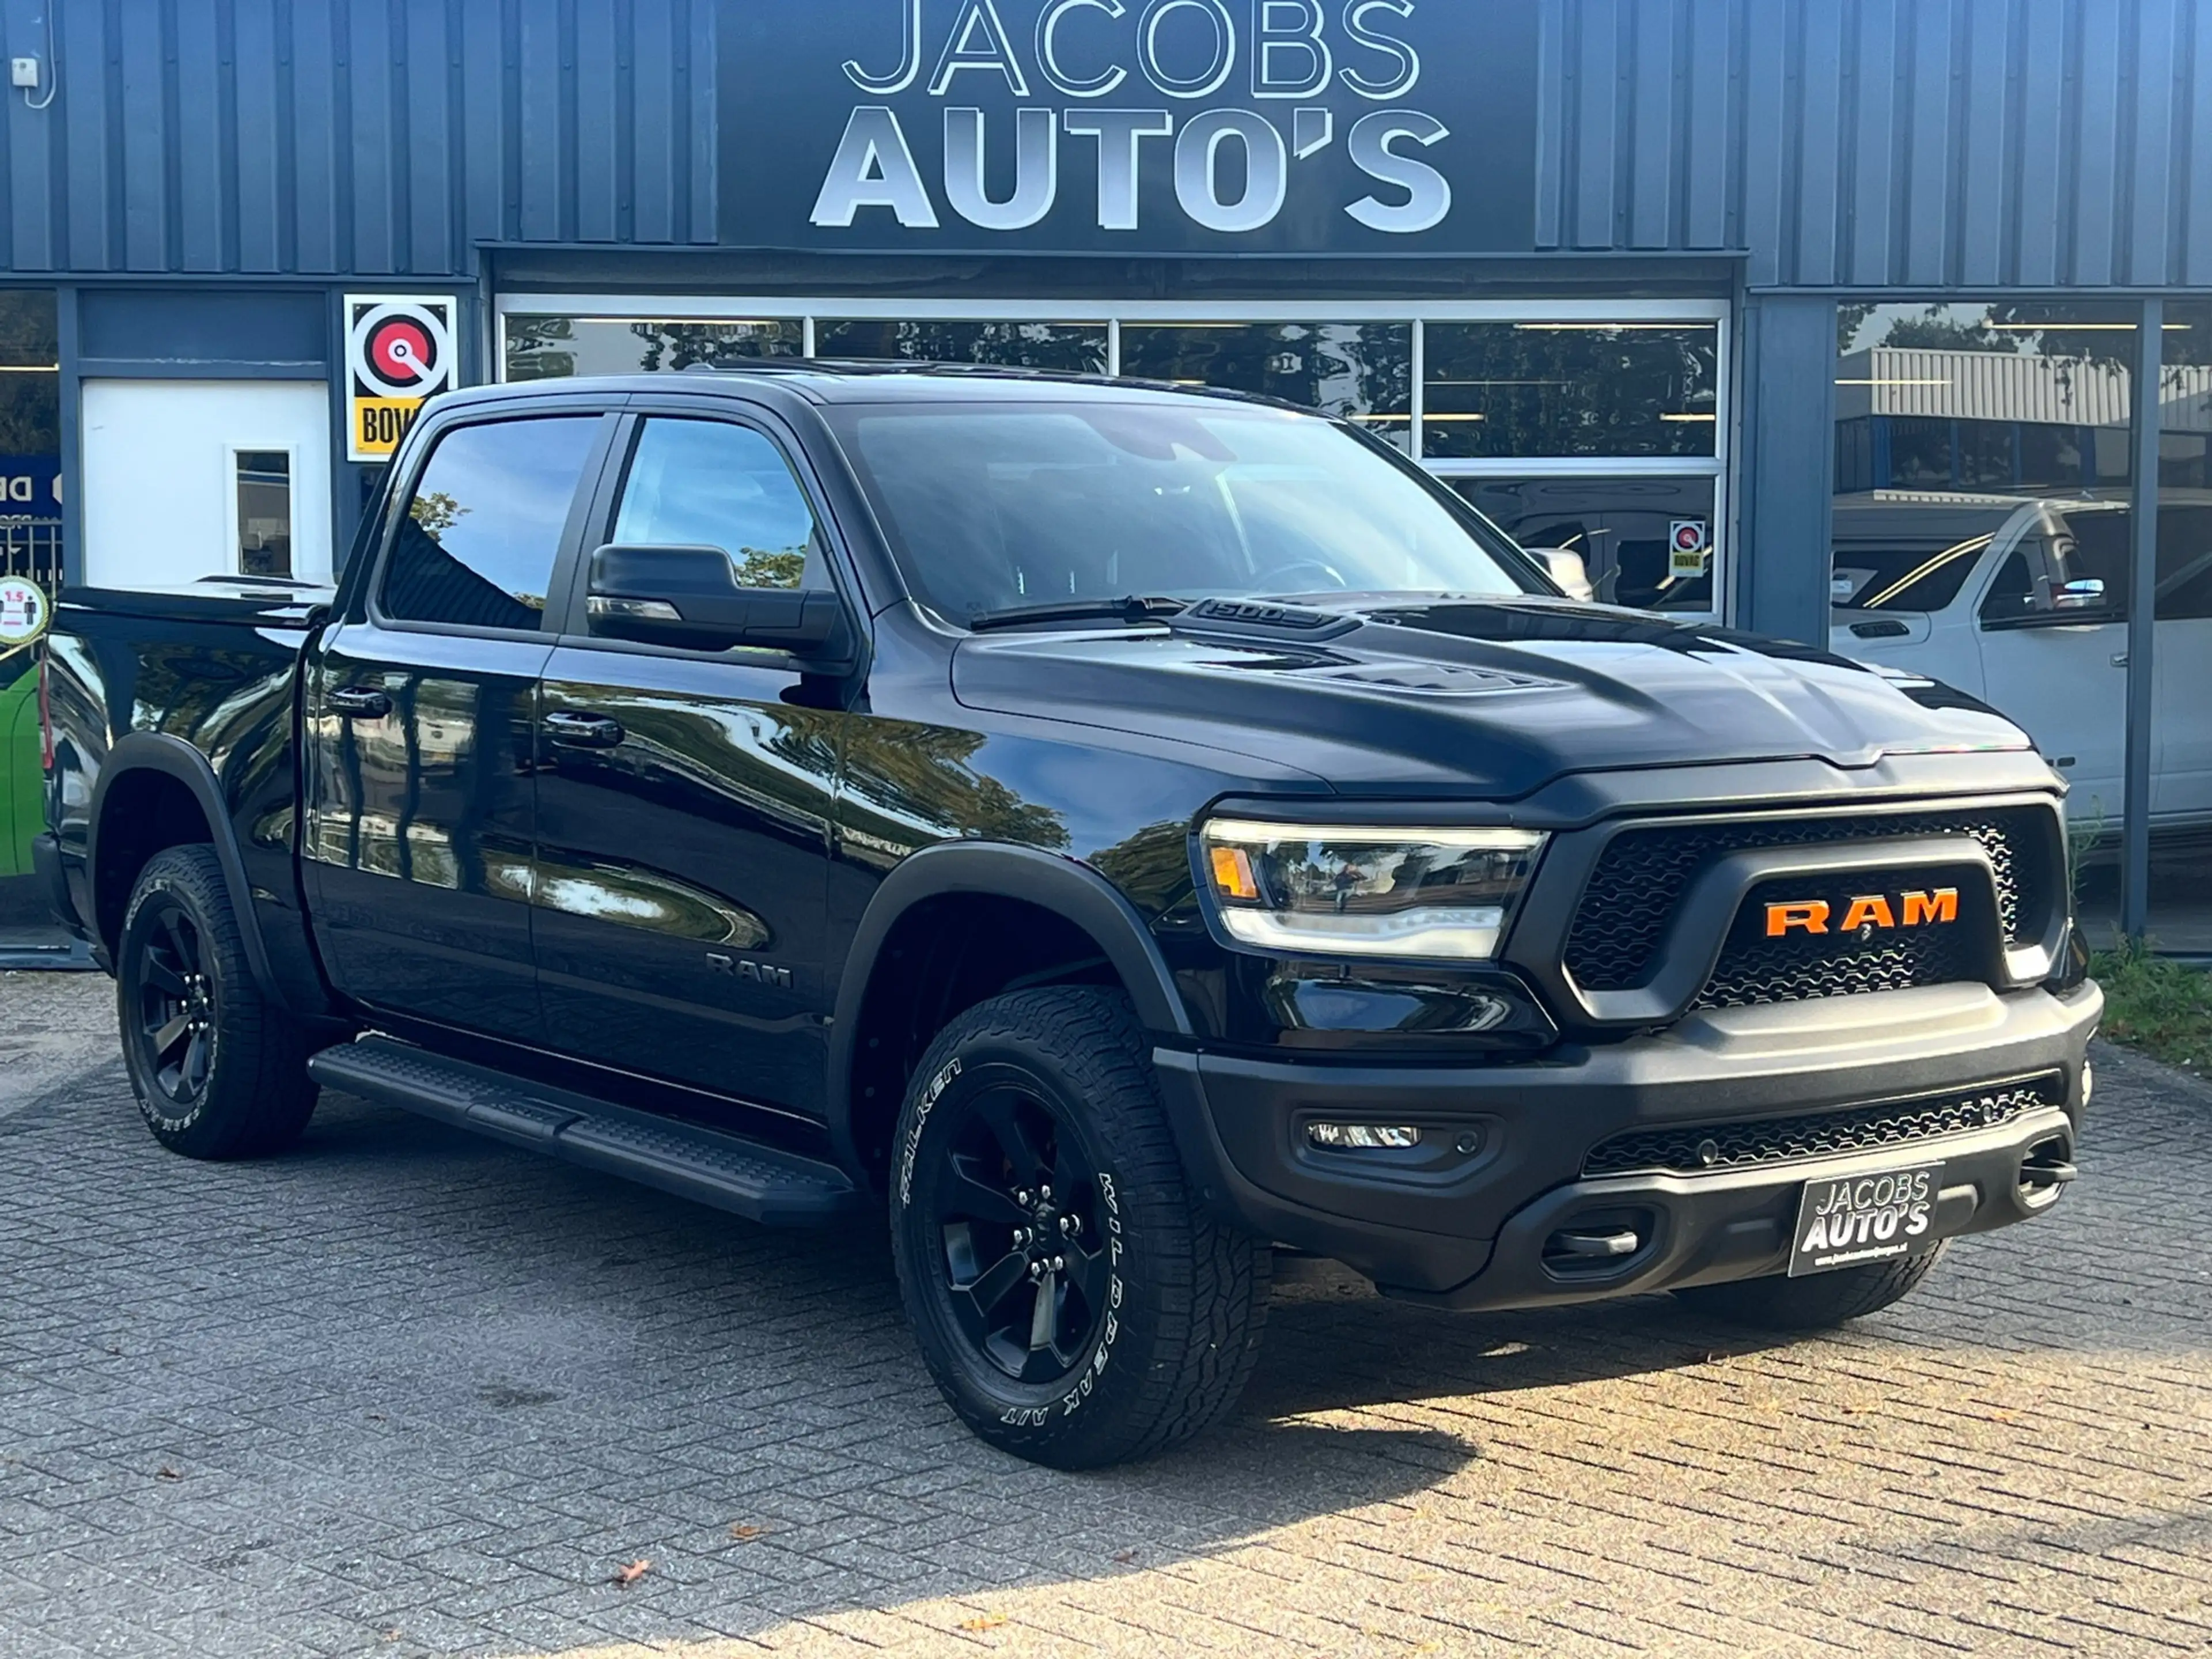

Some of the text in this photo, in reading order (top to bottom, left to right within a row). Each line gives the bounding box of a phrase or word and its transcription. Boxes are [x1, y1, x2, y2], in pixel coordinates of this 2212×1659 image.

[841, 0, 1421, 99] JACOBS
[809, 106, 1452, 232] AUTO'S
[363, 407, 418, 443] BOV
[1199, 599, 1285, 620] 1500
[1764, 888, 1957, 937] RAM
[706, 952, 792, 989] RAM
[1815, 1171, 1930, 1215] JACOBS
[1801, 1200, 1930, 1252] AUTO'S
[1000, 1172, 1123, 1426] WILDPEAK A/T
